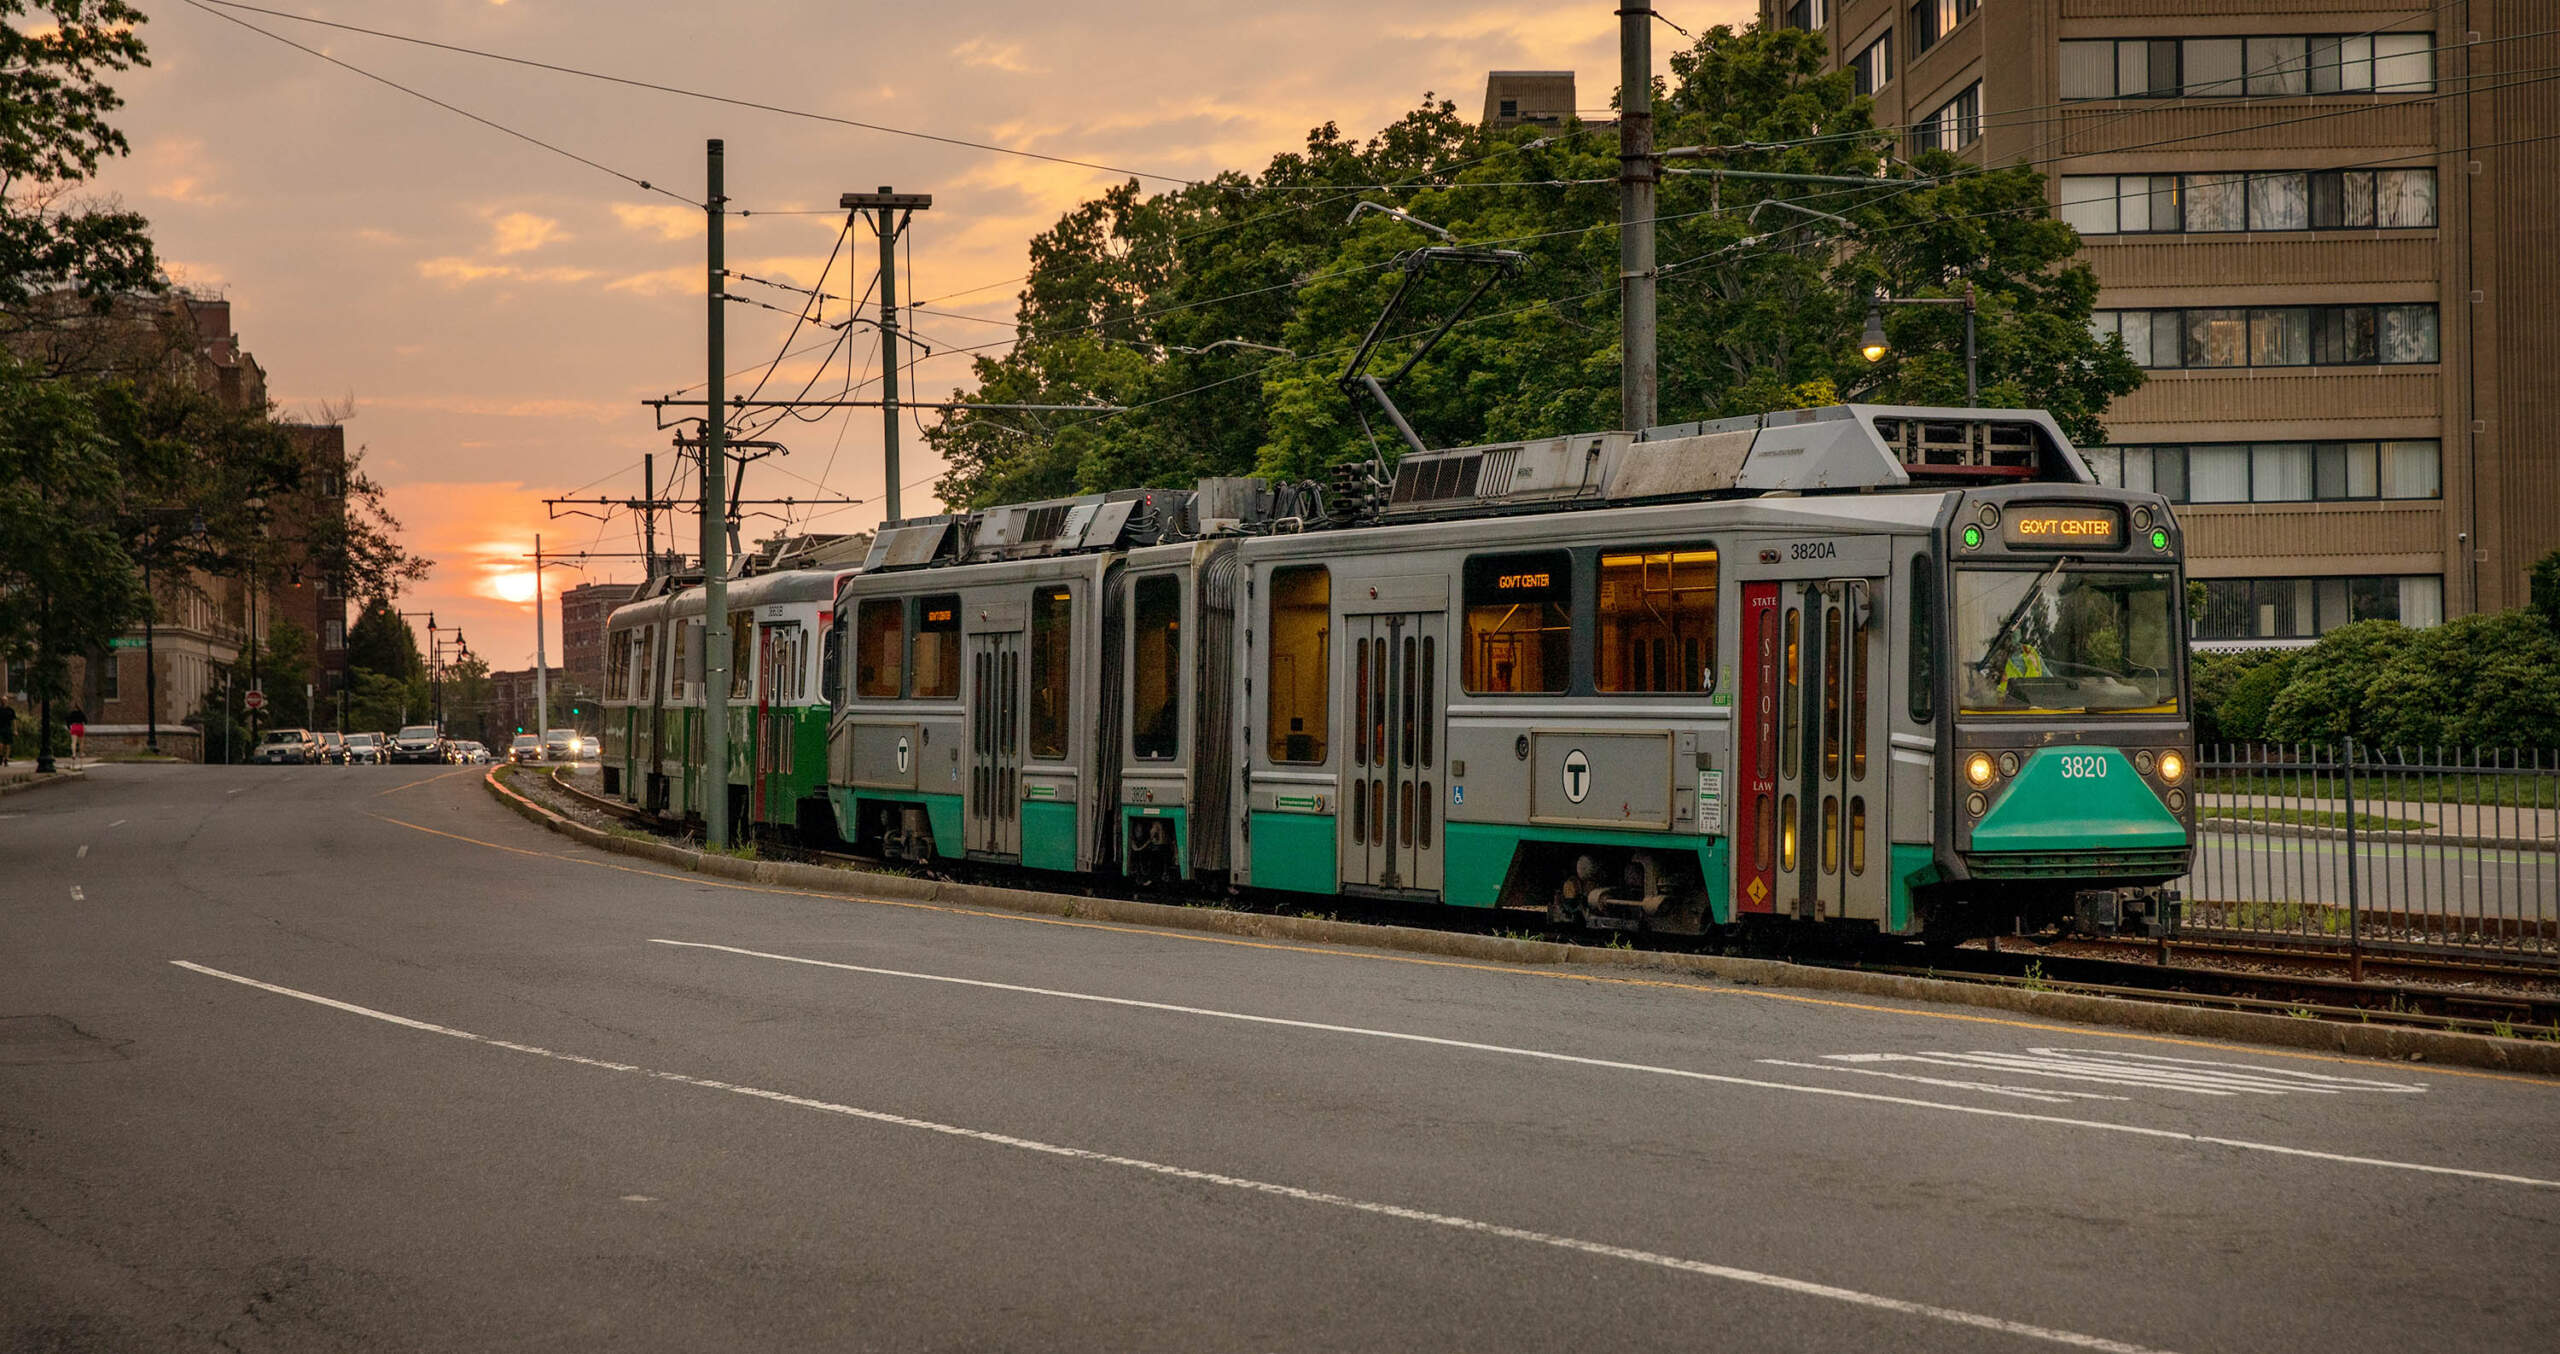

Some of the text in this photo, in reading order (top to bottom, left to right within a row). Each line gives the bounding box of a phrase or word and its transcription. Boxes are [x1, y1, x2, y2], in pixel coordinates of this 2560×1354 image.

[2019, 519, 2110, 535] GOV'T CENTER
[1791, 541, 1837, 560] 3820A
[1521, 573, 1550, 588] CENTER
[1752, 597, 1777, 607] STATE
[1762, 638, 1770, 741] STOP
[2061, 755, 2107, 778] 3820
[1567, 764, 1586, 796] T
[1752, 781, 1774, 792] LAW
